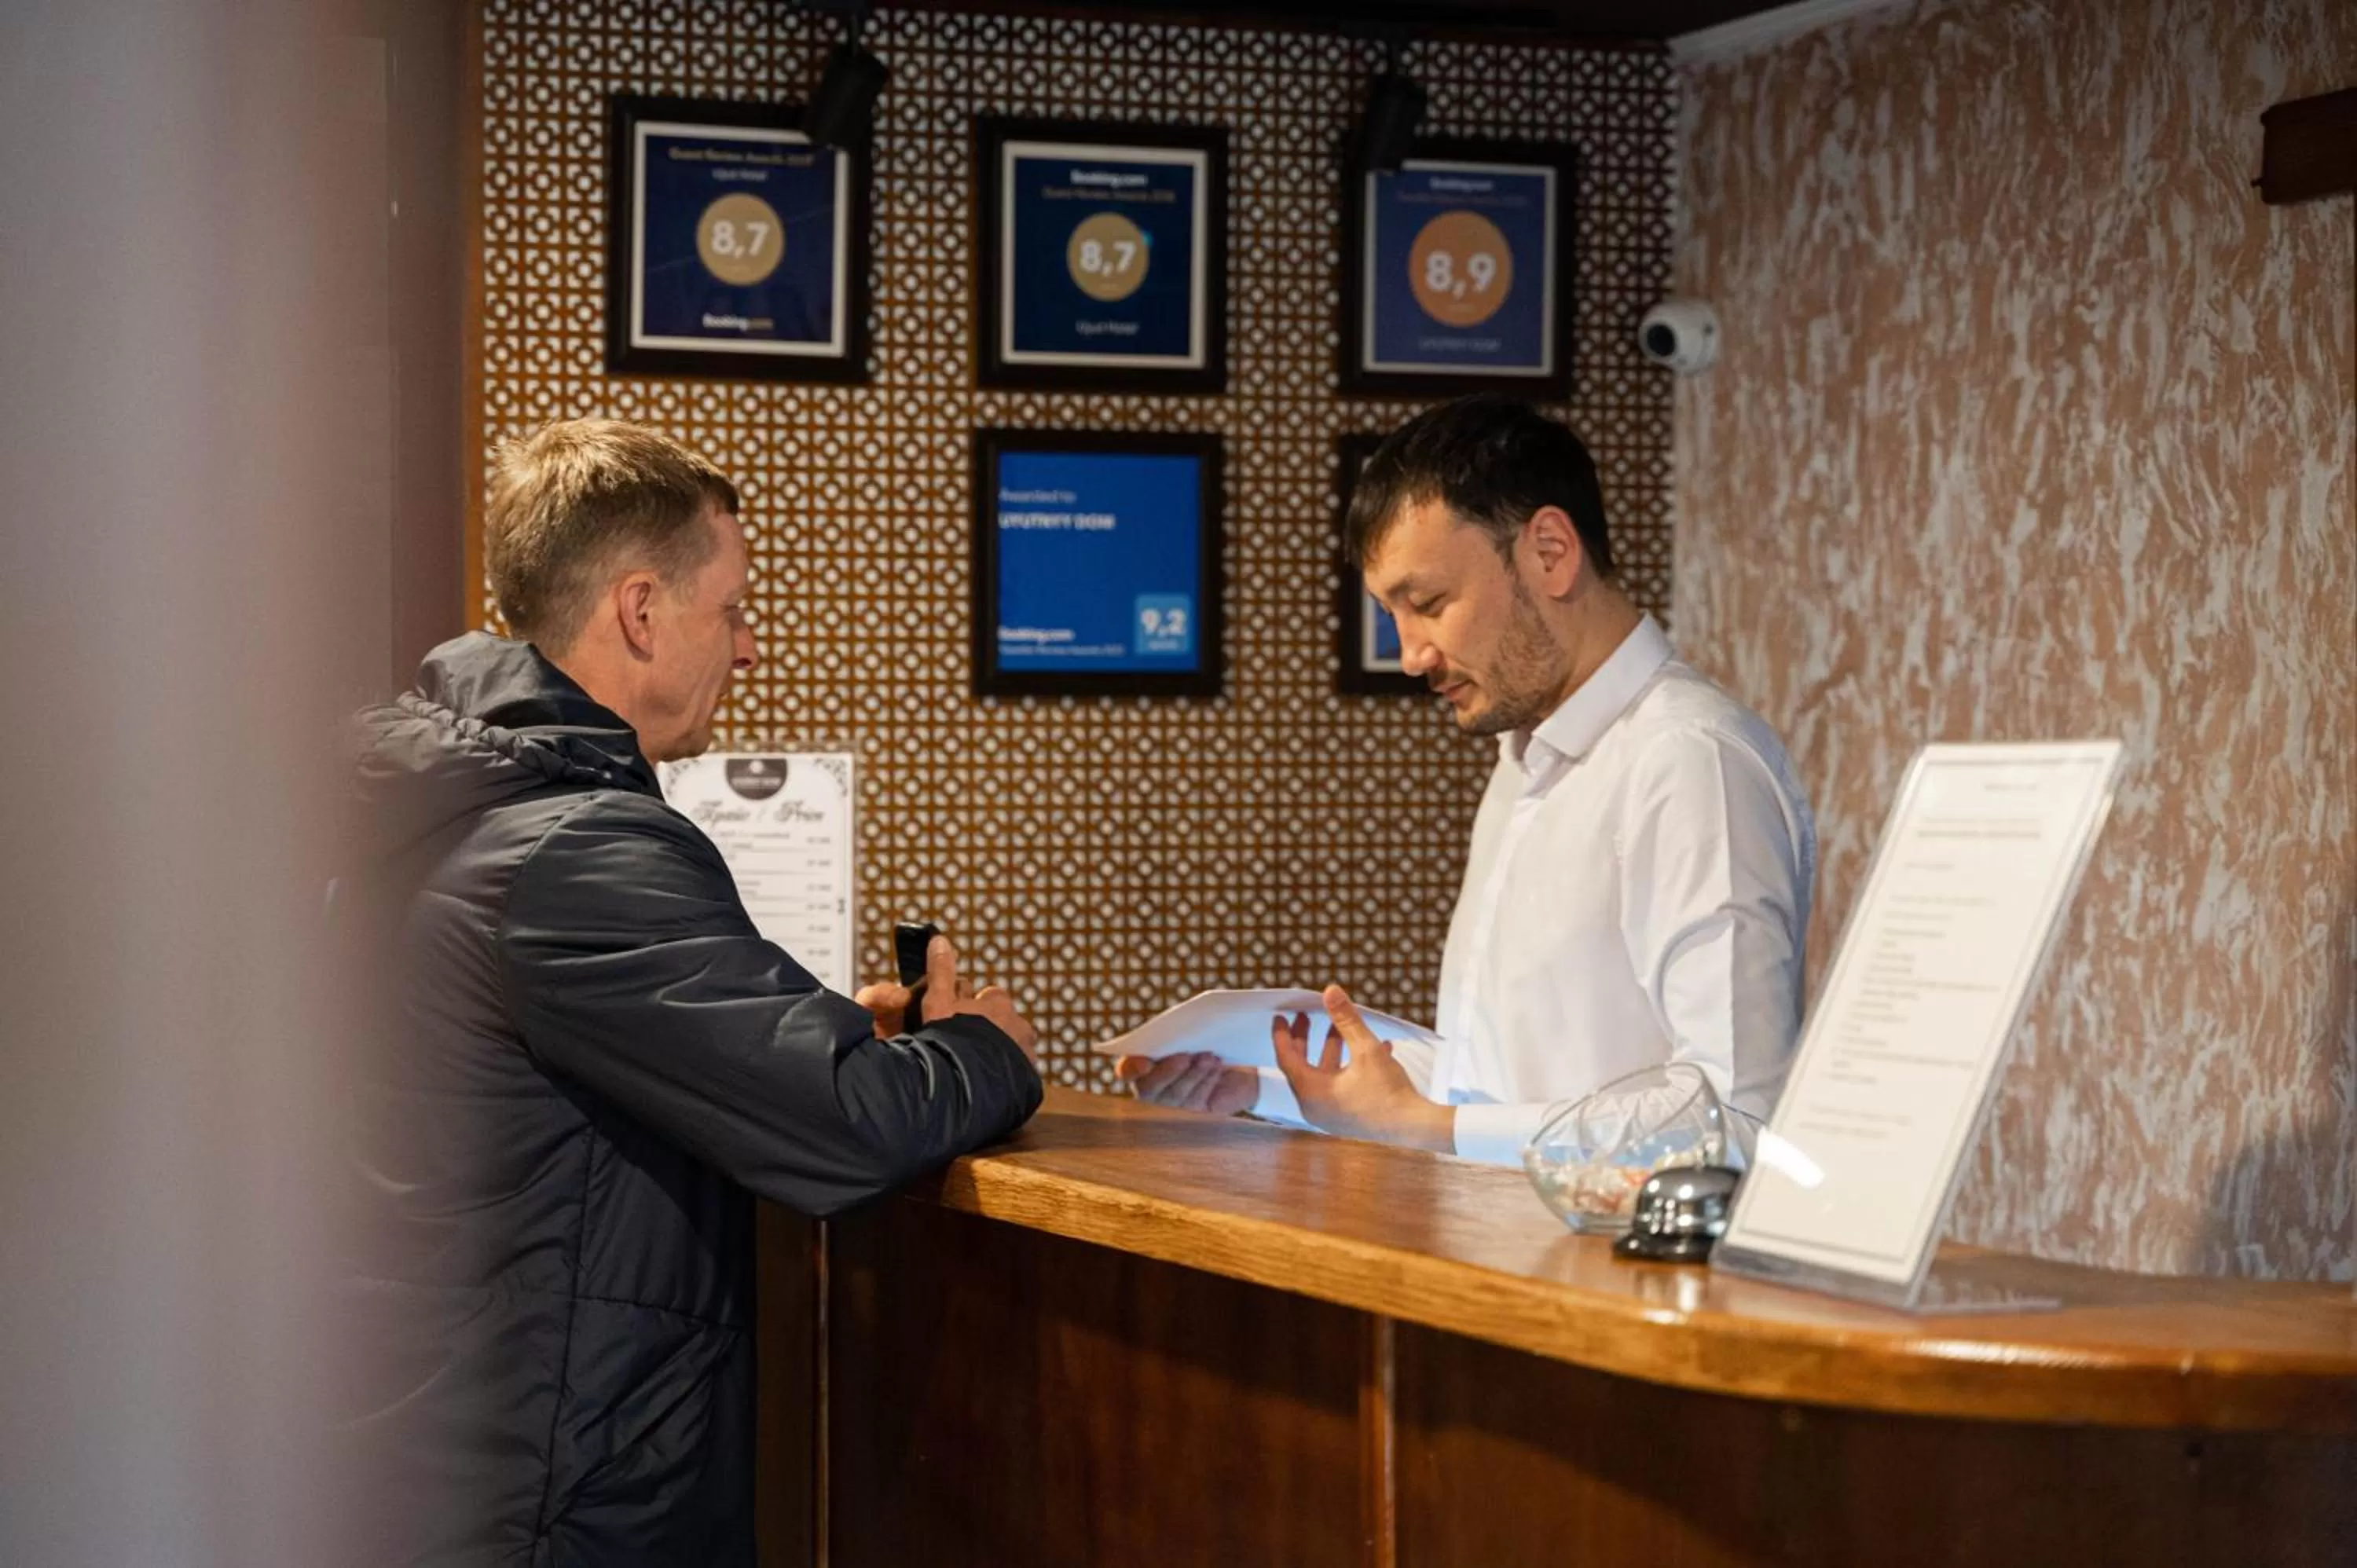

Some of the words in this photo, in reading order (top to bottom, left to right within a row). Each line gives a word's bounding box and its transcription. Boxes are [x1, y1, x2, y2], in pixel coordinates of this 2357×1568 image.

[710, 219, 771, 259] 8,7
[1079, 238, 1137, 277] 8,7
[1424, 250, 1497, 299] 8,9
[1141, 608, 1186, 638] 9,2
